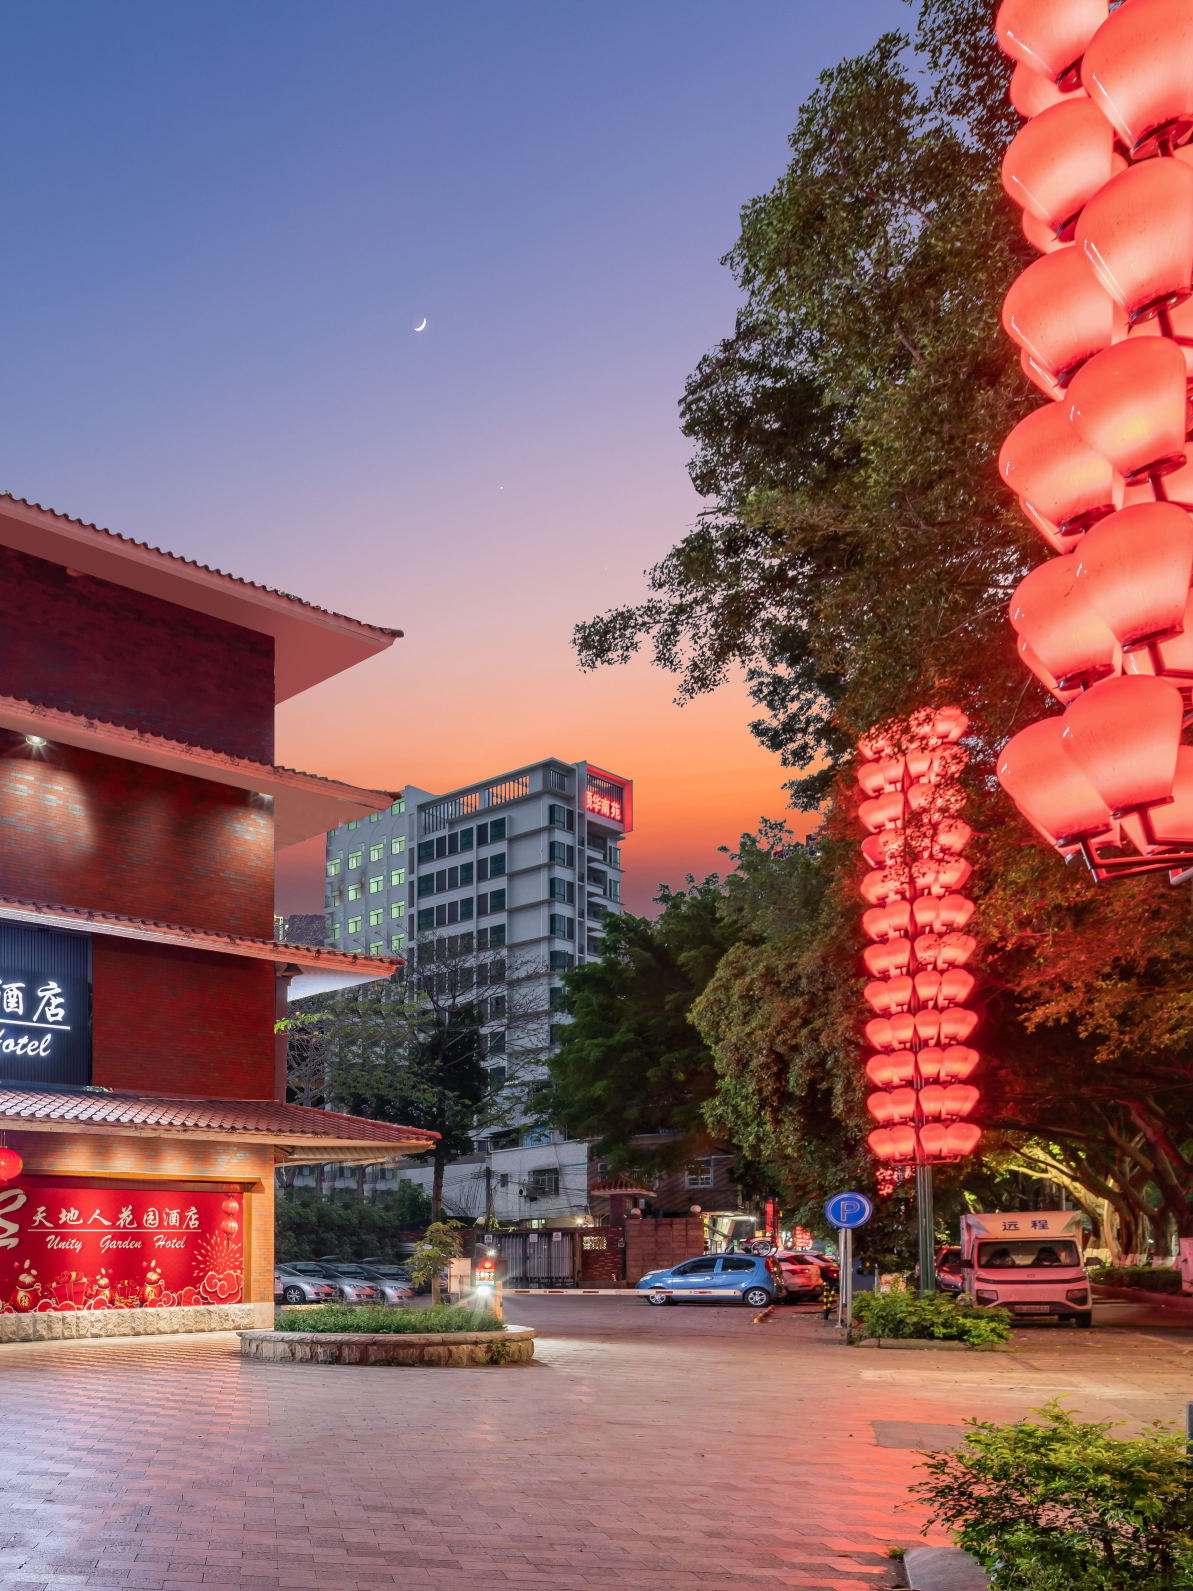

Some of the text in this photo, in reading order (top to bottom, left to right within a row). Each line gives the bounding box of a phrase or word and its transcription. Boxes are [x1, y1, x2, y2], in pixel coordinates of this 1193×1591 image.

[31, 1205, 200, 1229] 天地人花园酒店
[840, 1200, 861, 1222] P
[1002, 1219, 1050, 1232] 远程
[46, 1235, 186, 1253] Unity Garden Hotel
